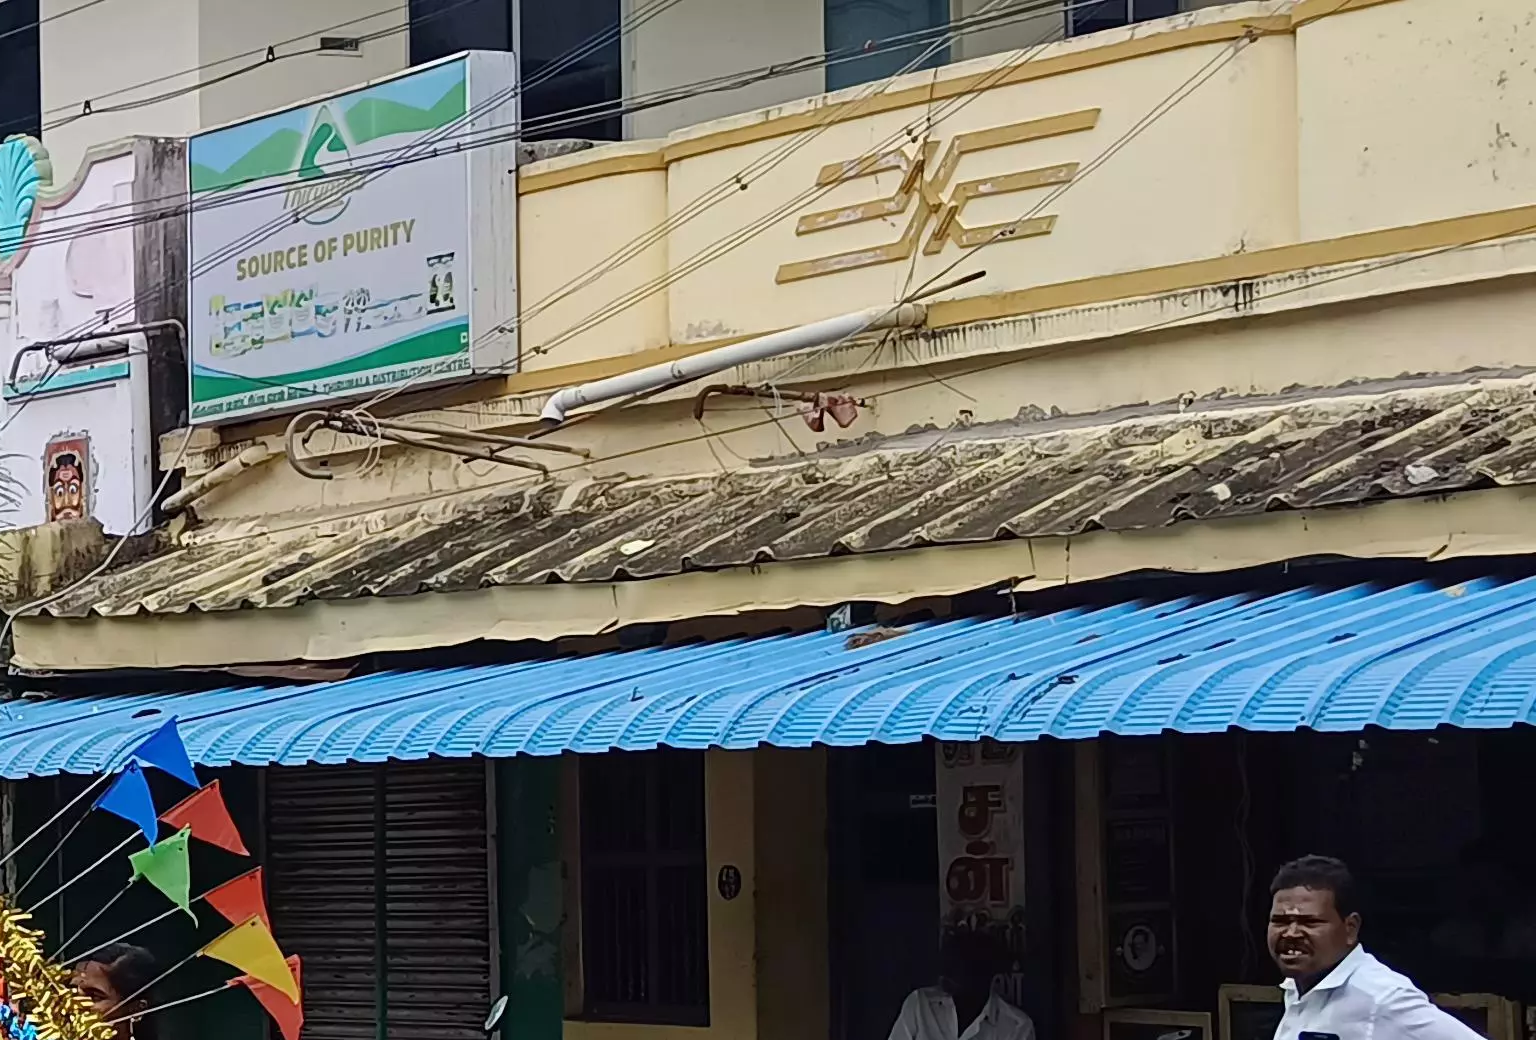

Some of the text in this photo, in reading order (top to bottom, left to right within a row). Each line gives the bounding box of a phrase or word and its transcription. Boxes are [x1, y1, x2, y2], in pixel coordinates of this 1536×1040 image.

[236, 218, 416, 281] SOURCE OF PURITY
